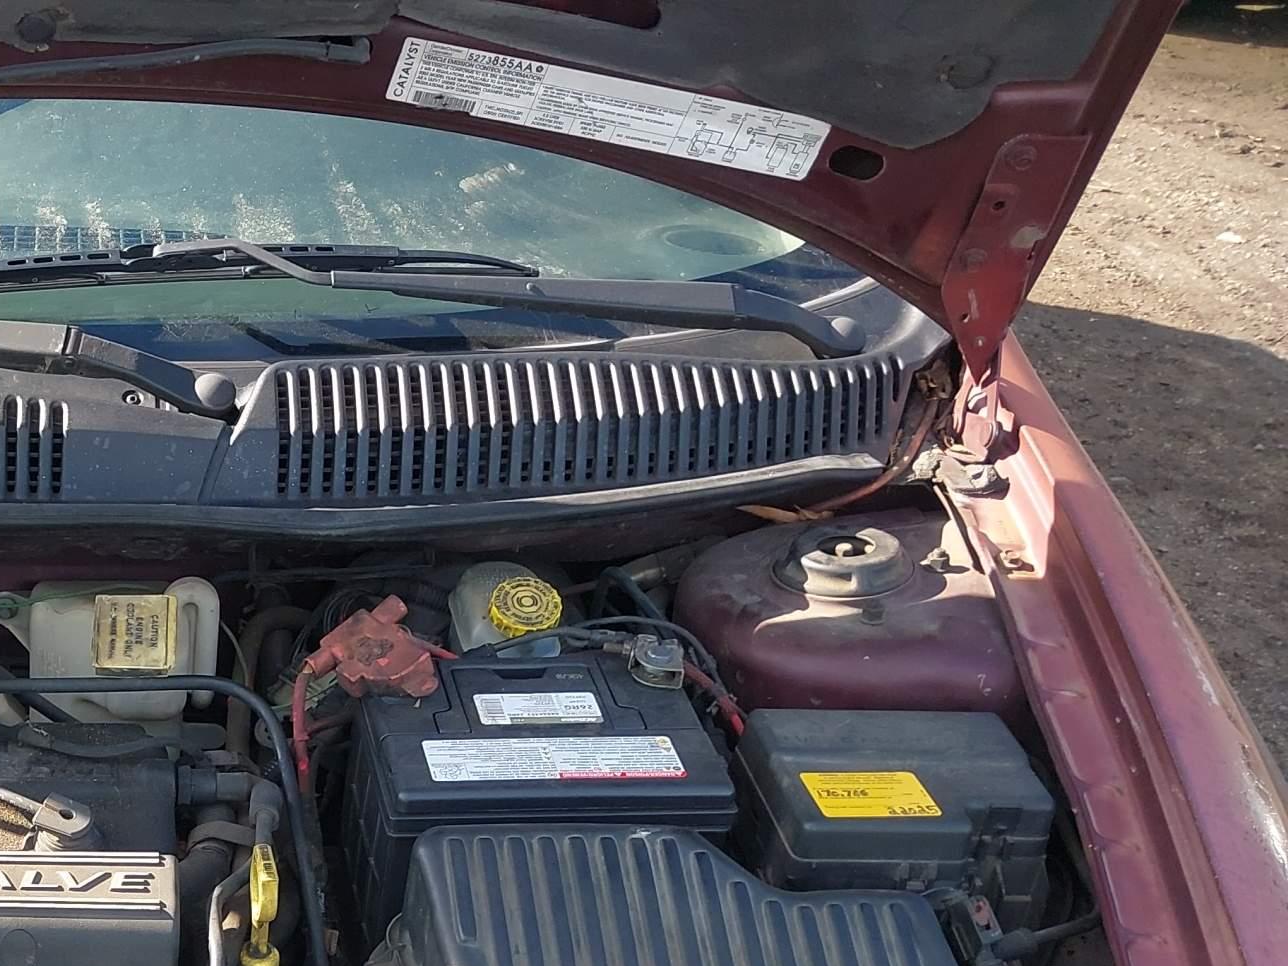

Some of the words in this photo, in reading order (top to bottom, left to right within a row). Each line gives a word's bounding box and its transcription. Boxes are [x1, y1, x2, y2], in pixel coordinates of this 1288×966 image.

[393, 41, 421, 97] CATALYST
[423, 53, 446, 62] VEHICLE
[447, 58, 474, 68] EMISSION
[474, 63, 502, 73] CONTROL
[502, 69, 542, 81] INFORMATION
[467, 52, 533, 70] 5273855AA
[151, 614, 160, 648] CAUTION
